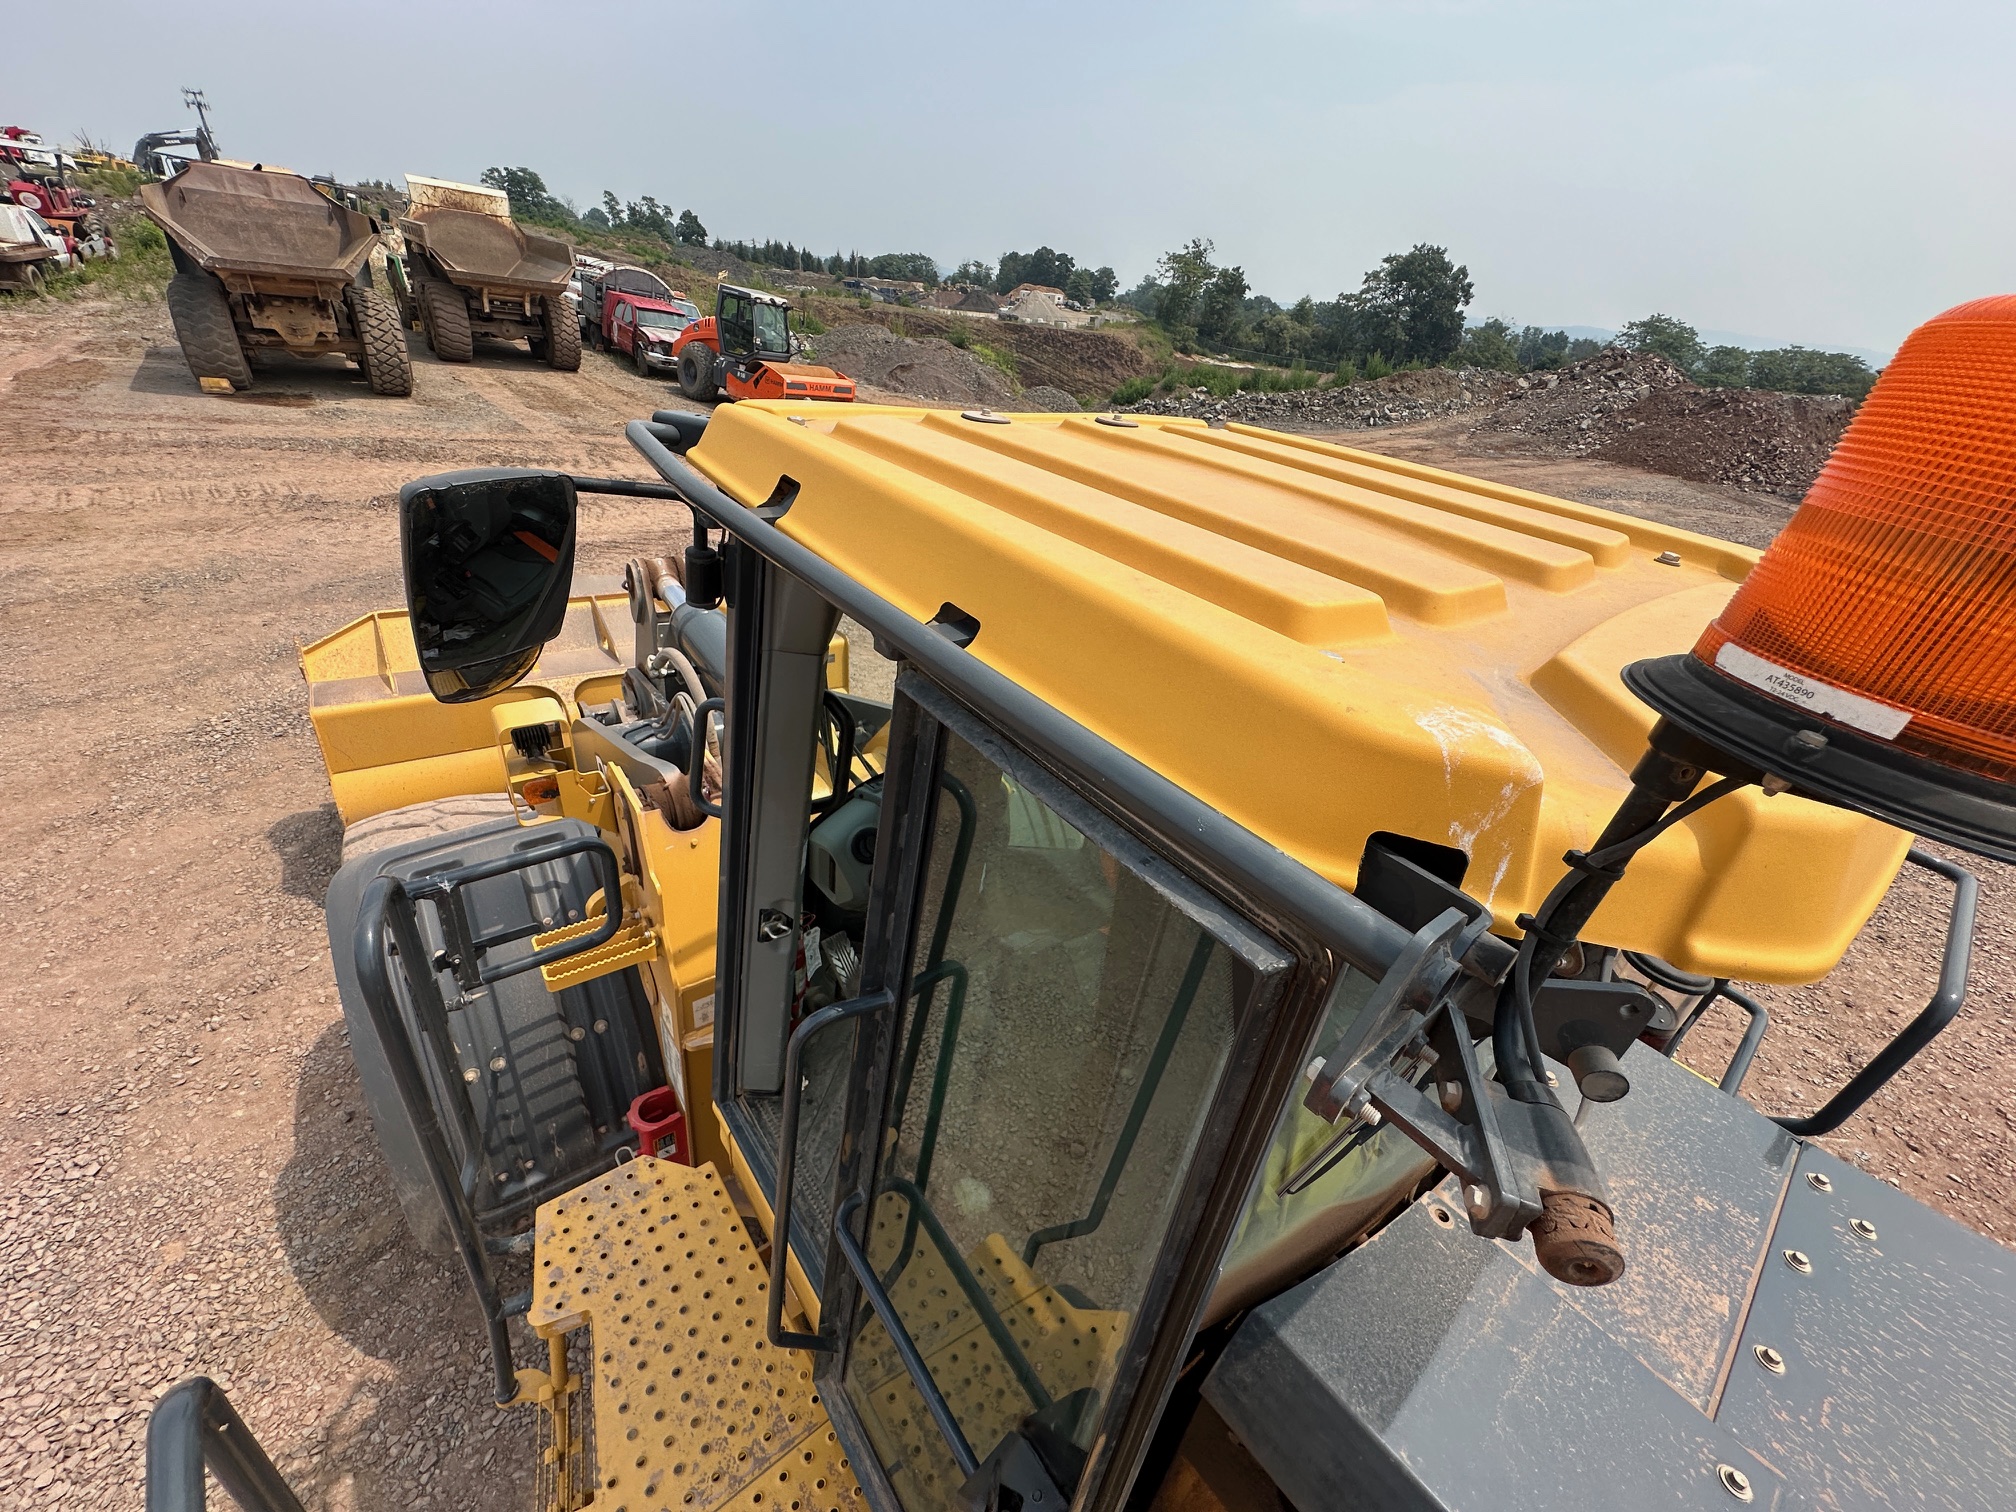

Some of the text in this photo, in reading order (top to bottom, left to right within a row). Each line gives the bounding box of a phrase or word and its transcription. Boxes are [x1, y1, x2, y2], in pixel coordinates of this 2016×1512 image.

[809, 384, 832, 393] HAMM
[1783, 673, 1804, 685] MODEL
[1765, 674, 1815, 699] AT435890
